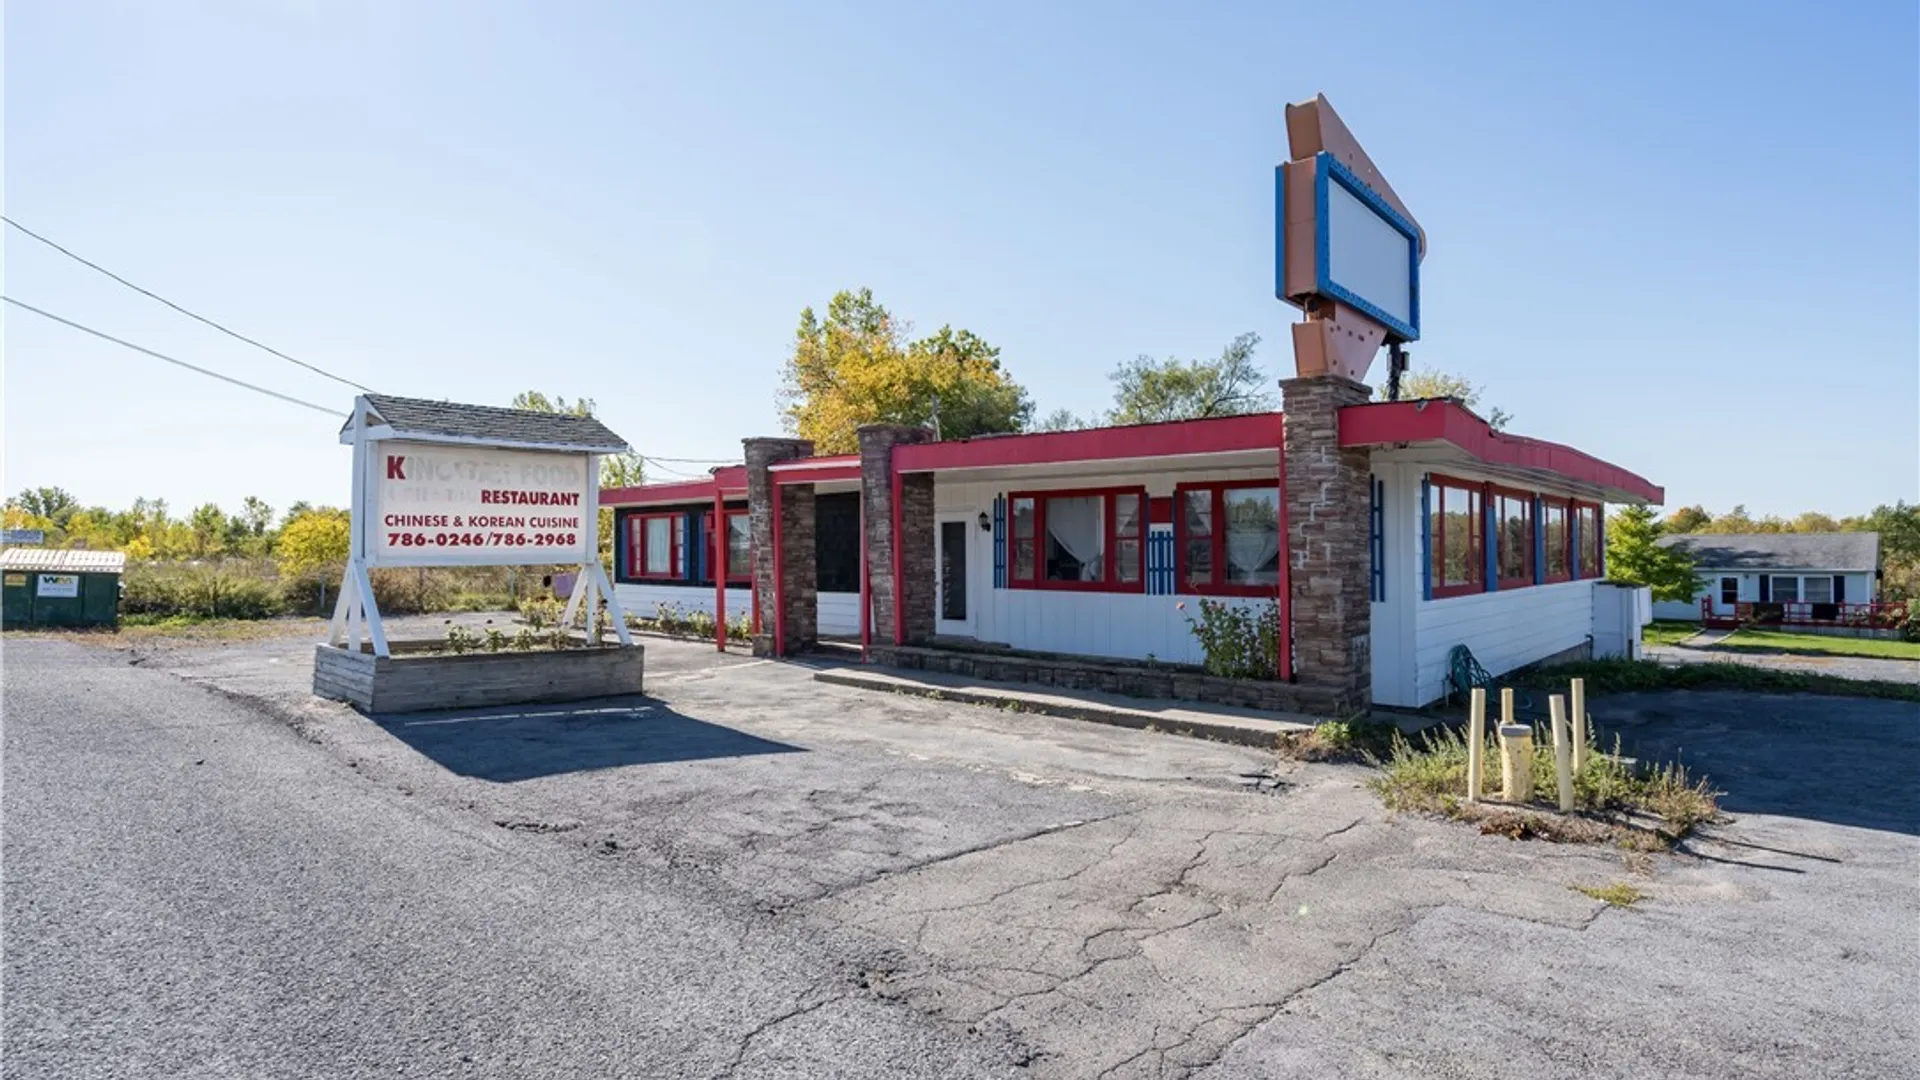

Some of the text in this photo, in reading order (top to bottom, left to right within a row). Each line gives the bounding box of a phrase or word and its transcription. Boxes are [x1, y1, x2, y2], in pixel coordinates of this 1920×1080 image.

[481, 489, 580, 506] RESTAURANT
[384, 514, 579, 529] CHINESE & KOREAN CUISINE
[387, 532, 577, 547] 786-0246/786-2968
